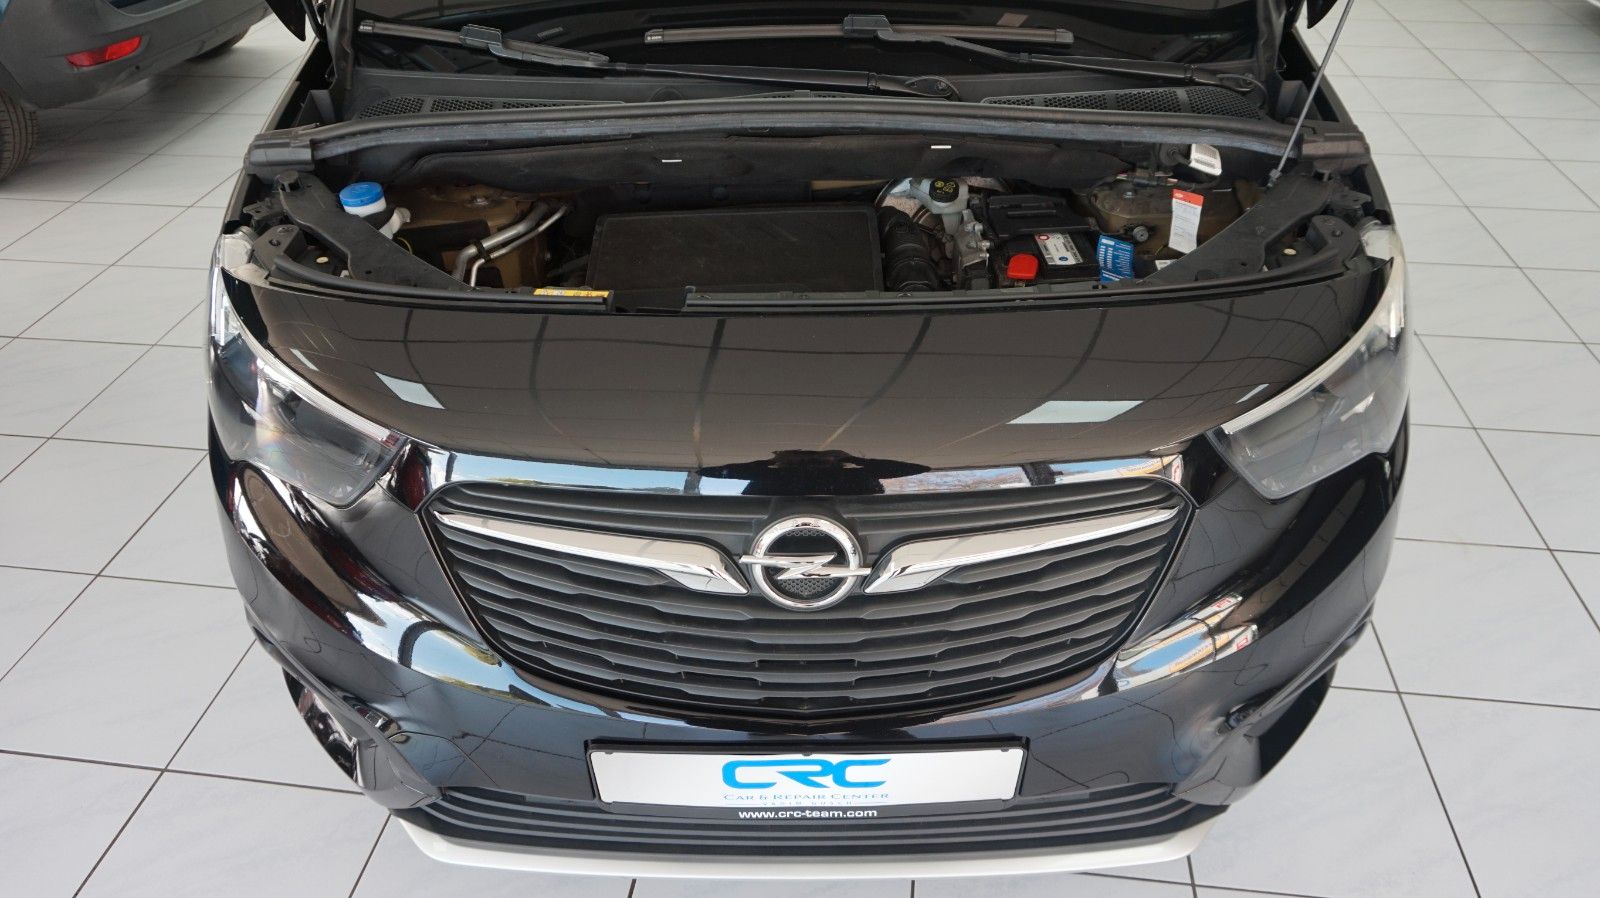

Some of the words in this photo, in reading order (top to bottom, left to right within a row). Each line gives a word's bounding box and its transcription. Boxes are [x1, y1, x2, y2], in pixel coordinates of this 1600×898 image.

[721, 758, 892, 789] CRC
[722, 793, 755, 801] CAR
[773, 793, 827, 801] REPAIR
[830, 792, 890, 800] CENTER
[738, 809, 878, 819] www.crc-team.com
